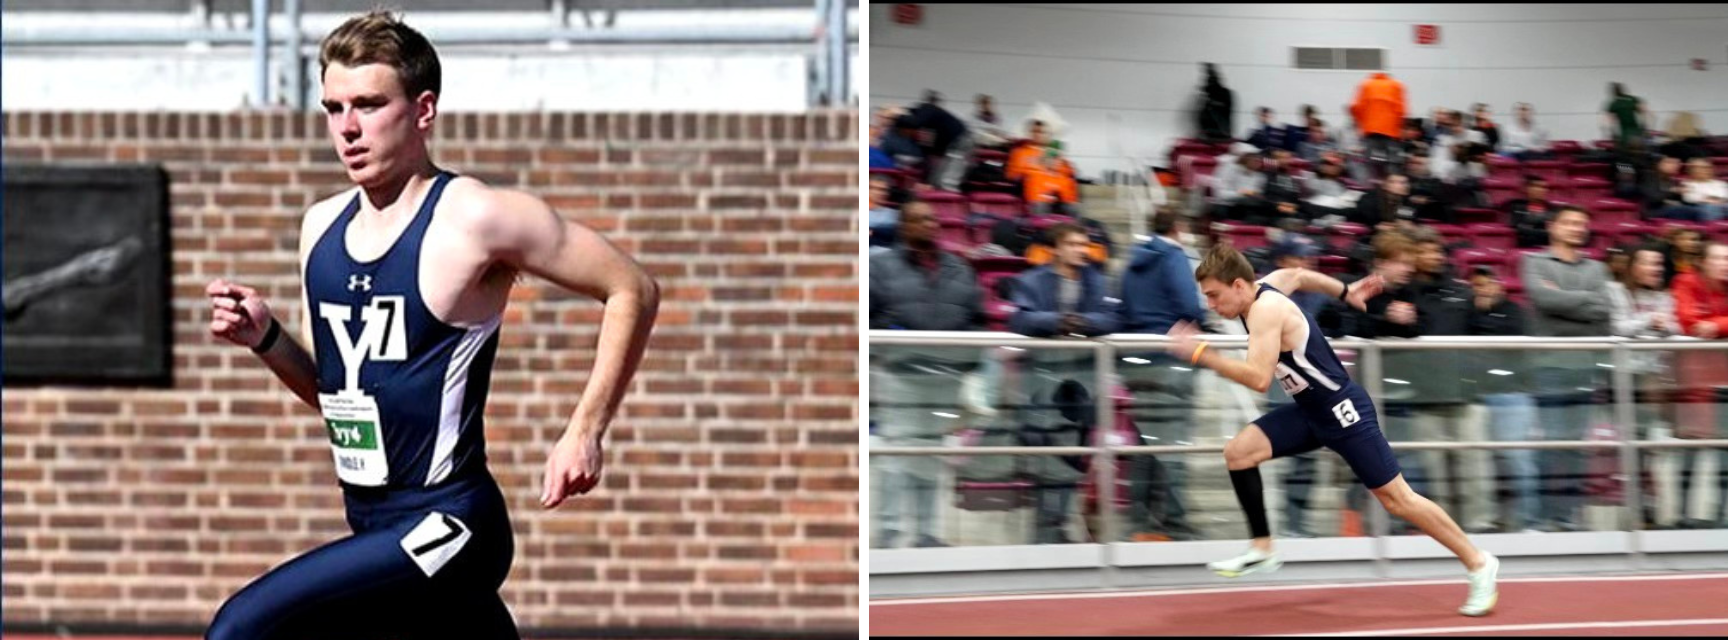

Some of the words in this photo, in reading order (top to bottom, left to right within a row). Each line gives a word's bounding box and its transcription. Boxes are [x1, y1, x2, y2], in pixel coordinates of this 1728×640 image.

[319, 301, 374, 395] Y
[377, 300, 396, 357] 7
[1339, 402, 1355, 423] 6
[411, 513, 465, 557] 7
